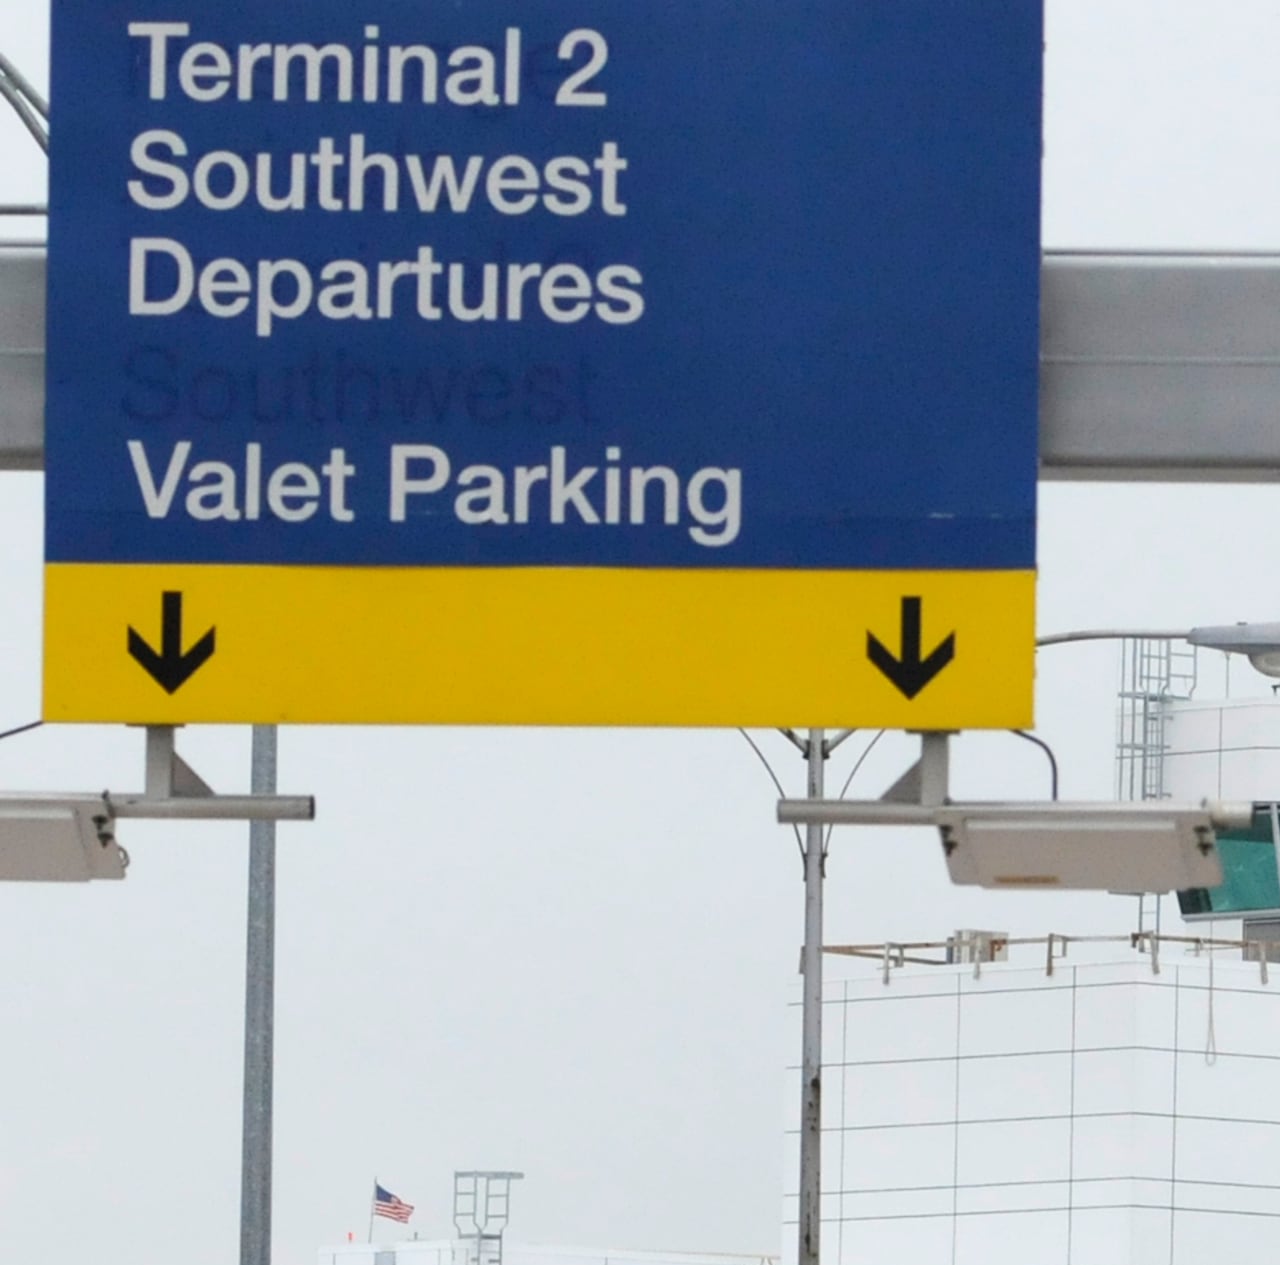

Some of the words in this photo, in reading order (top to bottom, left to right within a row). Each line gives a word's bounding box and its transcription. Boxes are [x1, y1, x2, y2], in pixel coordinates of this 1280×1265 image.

[127, 21, 521, 107] Terminal
[556, 28, 608, 108] 2
[127, 129, 627, 217] Southwest
[127, 237, 644, 337] Departures
[127, 440, 355, 522] Valet
[389, 443, 742, 547] Parking
